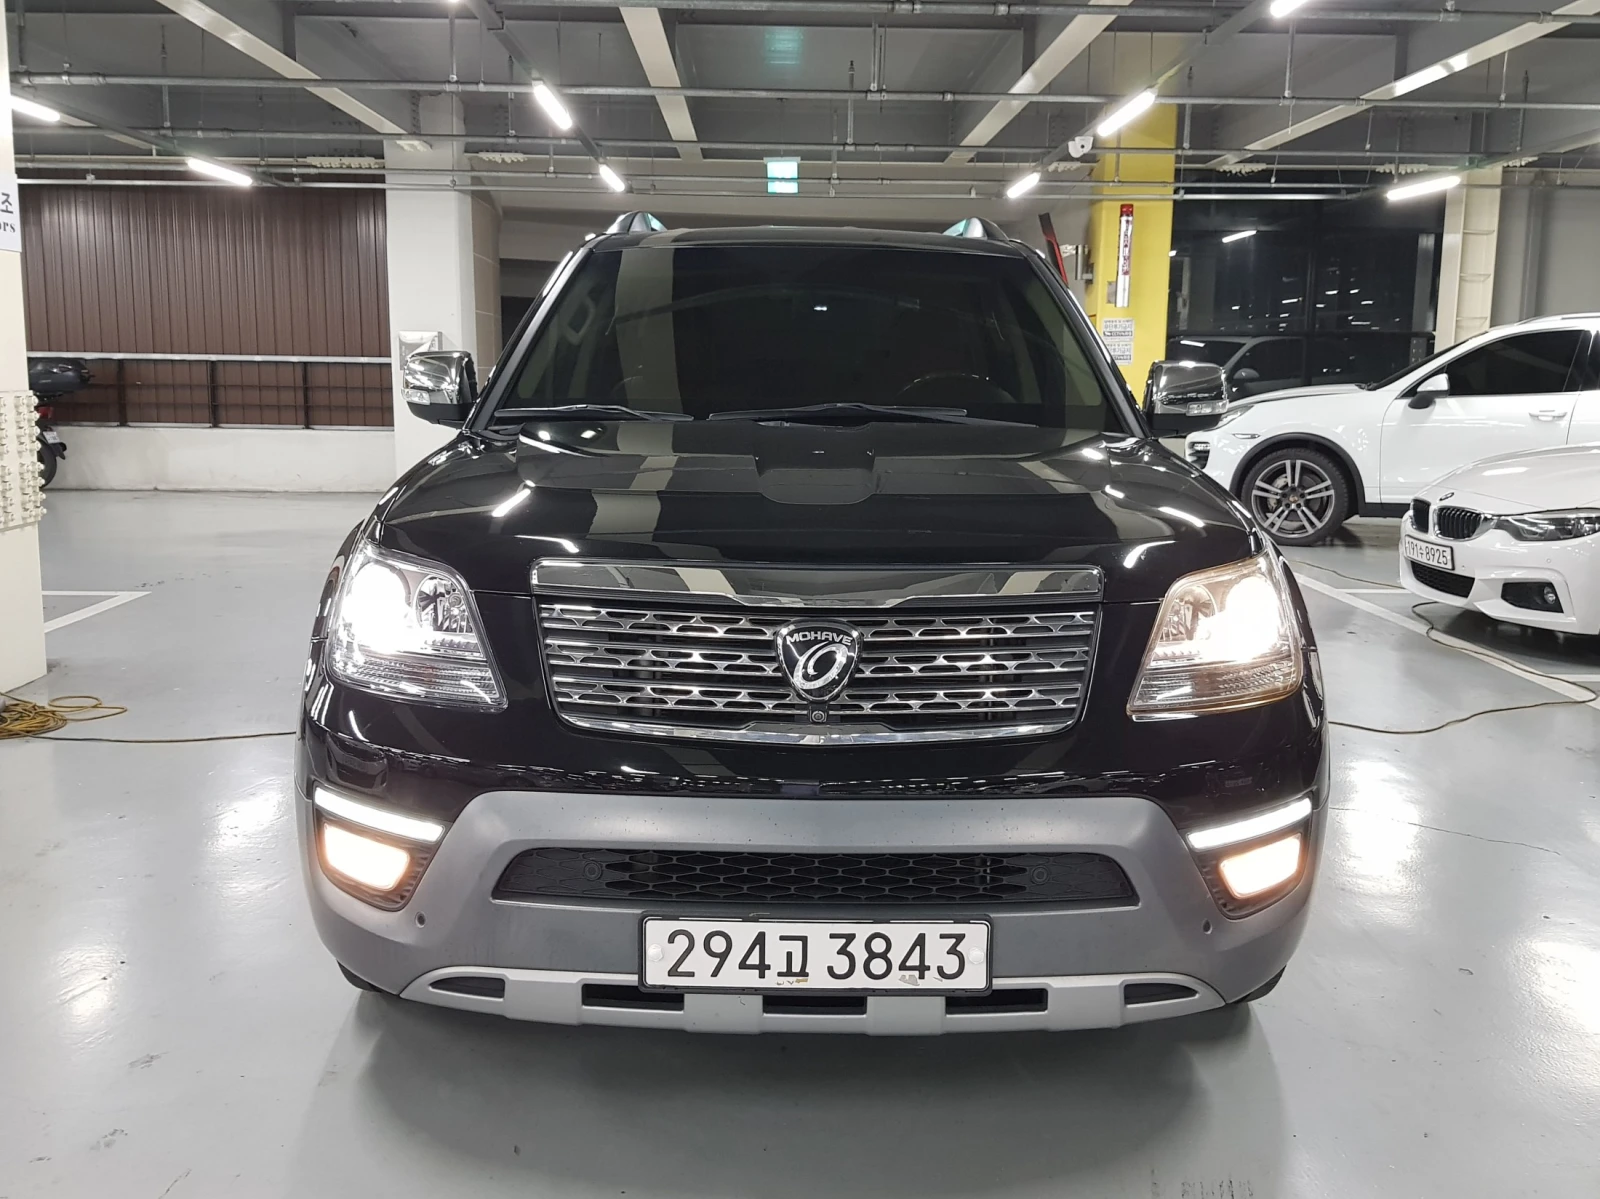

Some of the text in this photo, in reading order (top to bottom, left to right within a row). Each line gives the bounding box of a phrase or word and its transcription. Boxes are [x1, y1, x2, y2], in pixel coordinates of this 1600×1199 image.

[0, 192, 14, 214] 조
[1407, 541, 1448, 566] 191수8925
[785, 631, 854, 646] MOHAVE
[667, 929, 966, 981] 294고 3843
